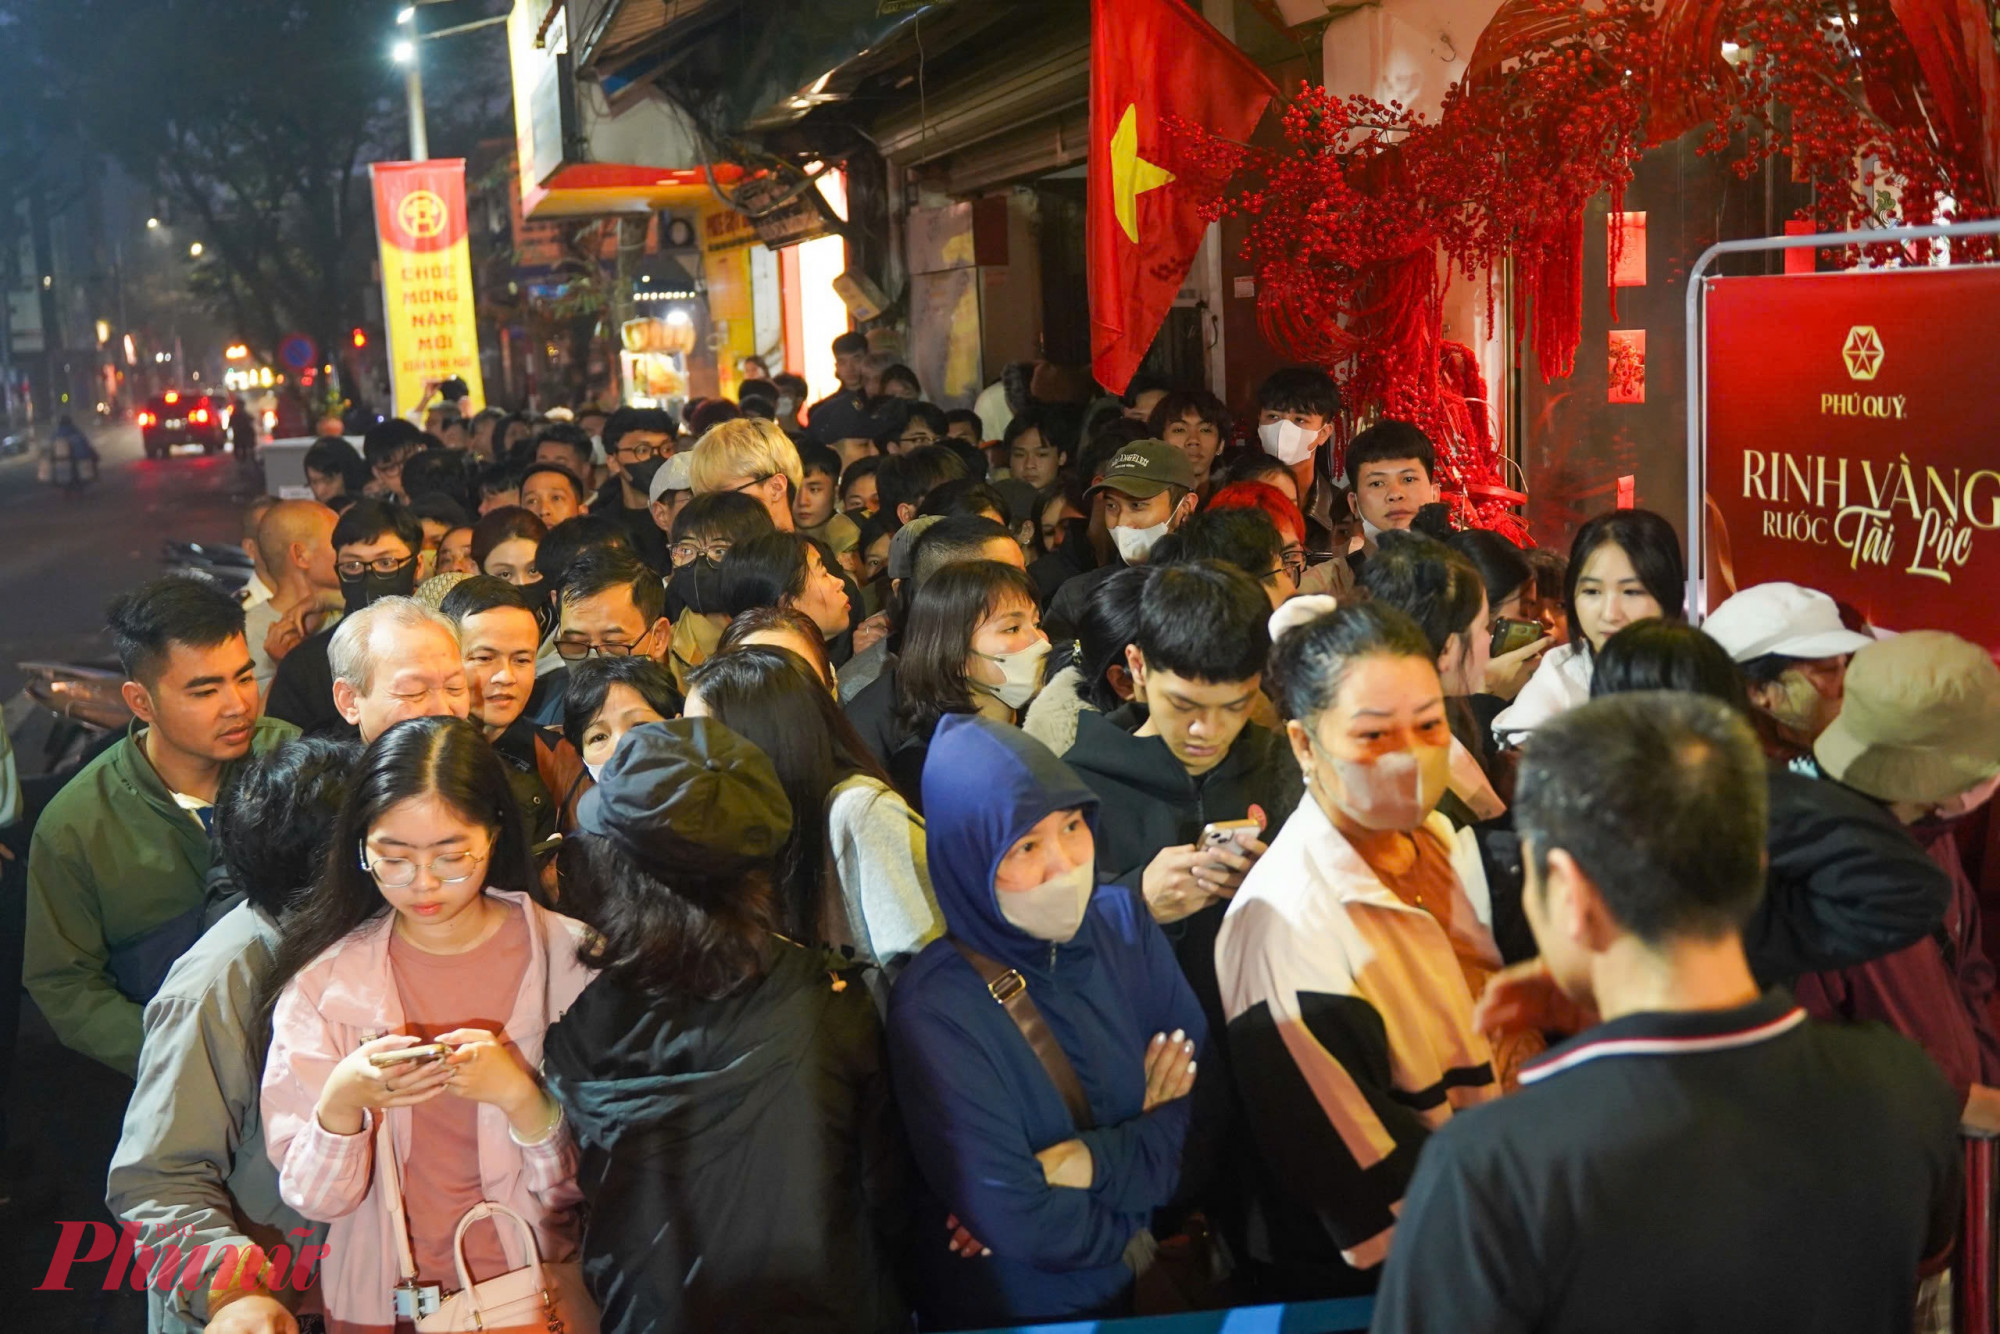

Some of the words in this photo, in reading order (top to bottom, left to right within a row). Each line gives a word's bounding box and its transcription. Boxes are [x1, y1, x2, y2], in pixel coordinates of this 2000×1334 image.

[1821, 392, 1860, 416] PHÚ
[1862, 394, 1906, 419] QUÝ
[1743, 449, 1848, 509] RINH
[1861, 451, 2000, 530] VÀNG
[1763, 509, 1828, 545] RƯỚC
[1834, 505, 1895, 570] Tài
[1905, 507, 1973, 584] Lộc
